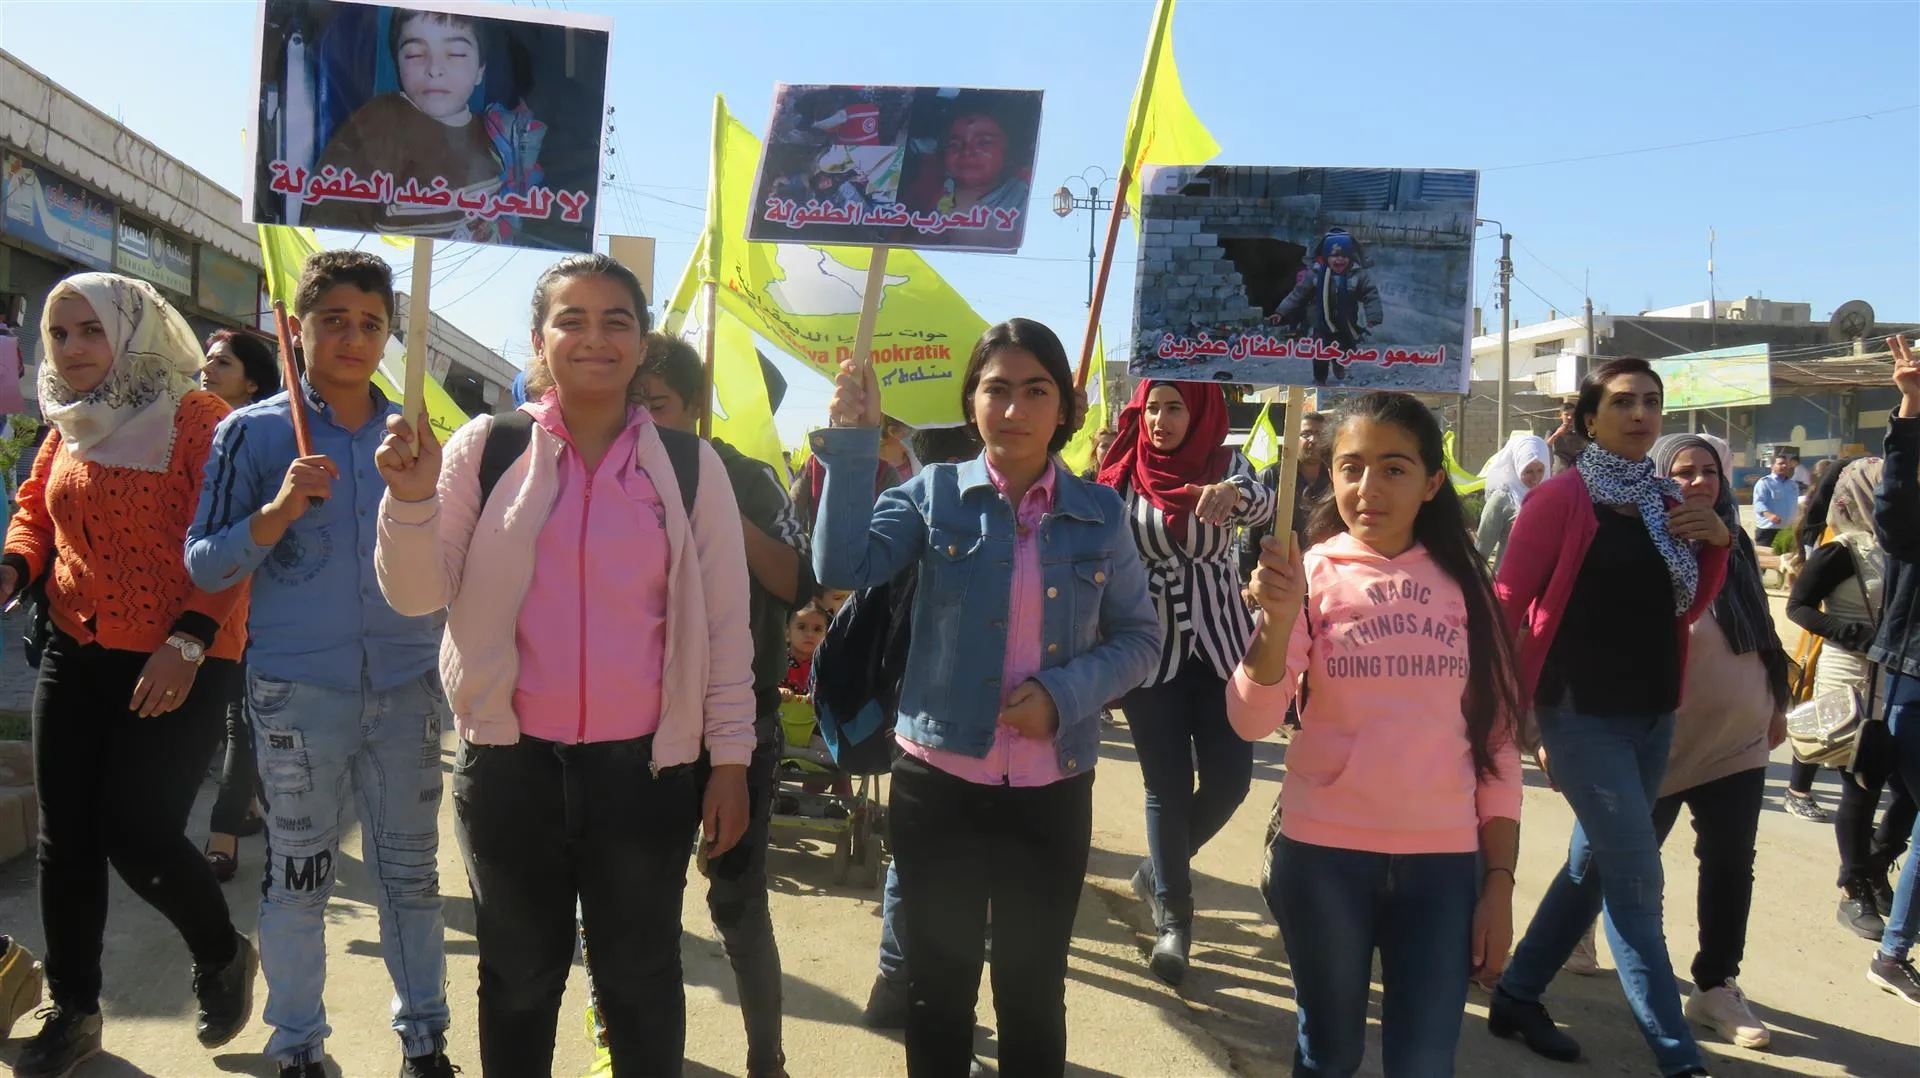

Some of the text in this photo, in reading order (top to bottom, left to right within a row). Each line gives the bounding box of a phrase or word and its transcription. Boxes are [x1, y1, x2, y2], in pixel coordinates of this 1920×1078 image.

[269, 160, 590, 222] لا للحرب ضد الطفولة
[764, 195, 1020, 233] لا للحرب ضد الطفولة
[1158, 331, 1446, 369] اسمعو صرخات اطفال عفرين
[1365, 579, 1432, 605] MAGIC
[1344, 613, 1460, 649] THINGS ARE
[1327, 655, 1382, 679] GOING
[285, 849, 333, 892] MD
